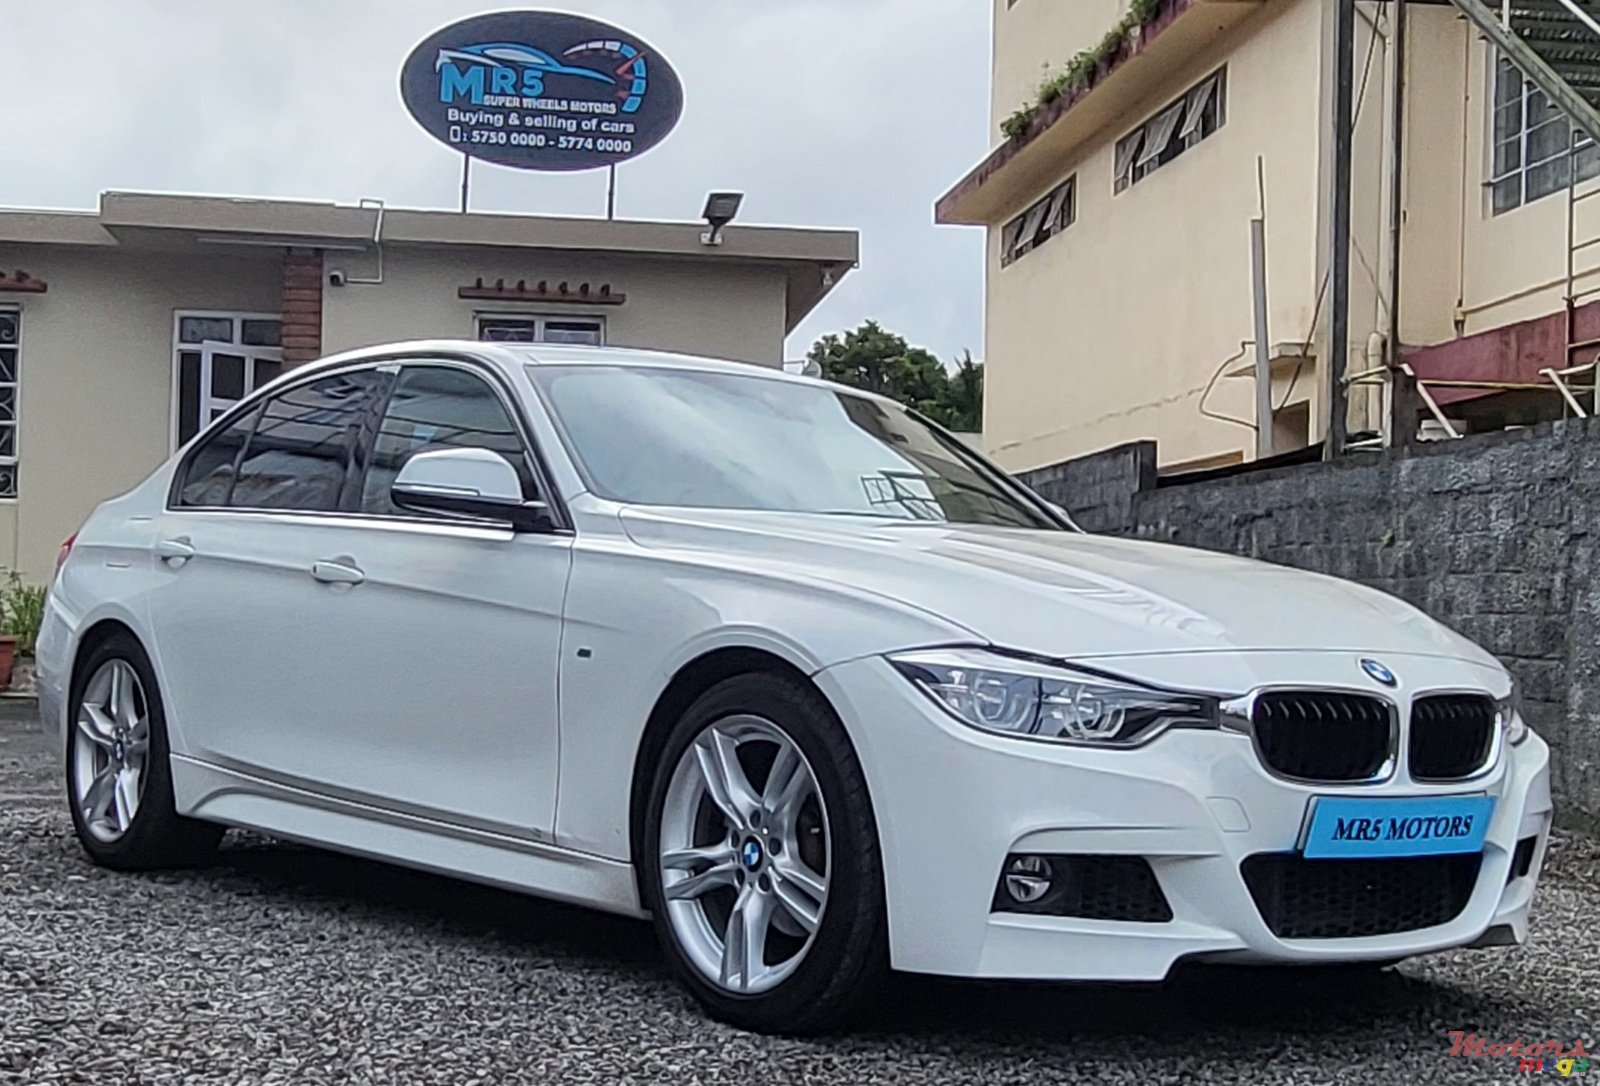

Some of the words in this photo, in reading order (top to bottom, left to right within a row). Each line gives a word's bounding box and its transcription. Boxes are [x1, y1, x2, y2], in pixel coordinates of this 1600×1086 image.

[483, 94, 520, 108] SUPER
[522, 98, 568, 111] WHEELS
[570, 101, 616, 114] MOTORS
[447, 108, 504, 126] Buying
[508, 112, 520, 125] &
[524, 114, 577, 132] selling
[581, 118, 599, 131] of
[600, 121, 635, 133] cars
[470, 130, 507, 145] 5750
[510, 132, 546, 146] 0000
[558, 136, 593, 149] 5774
[596, 138, 632, 152] 0000
[1331, 818, 1384, 841] MR5
[1383, 815, 1474, 841] MOTORS
